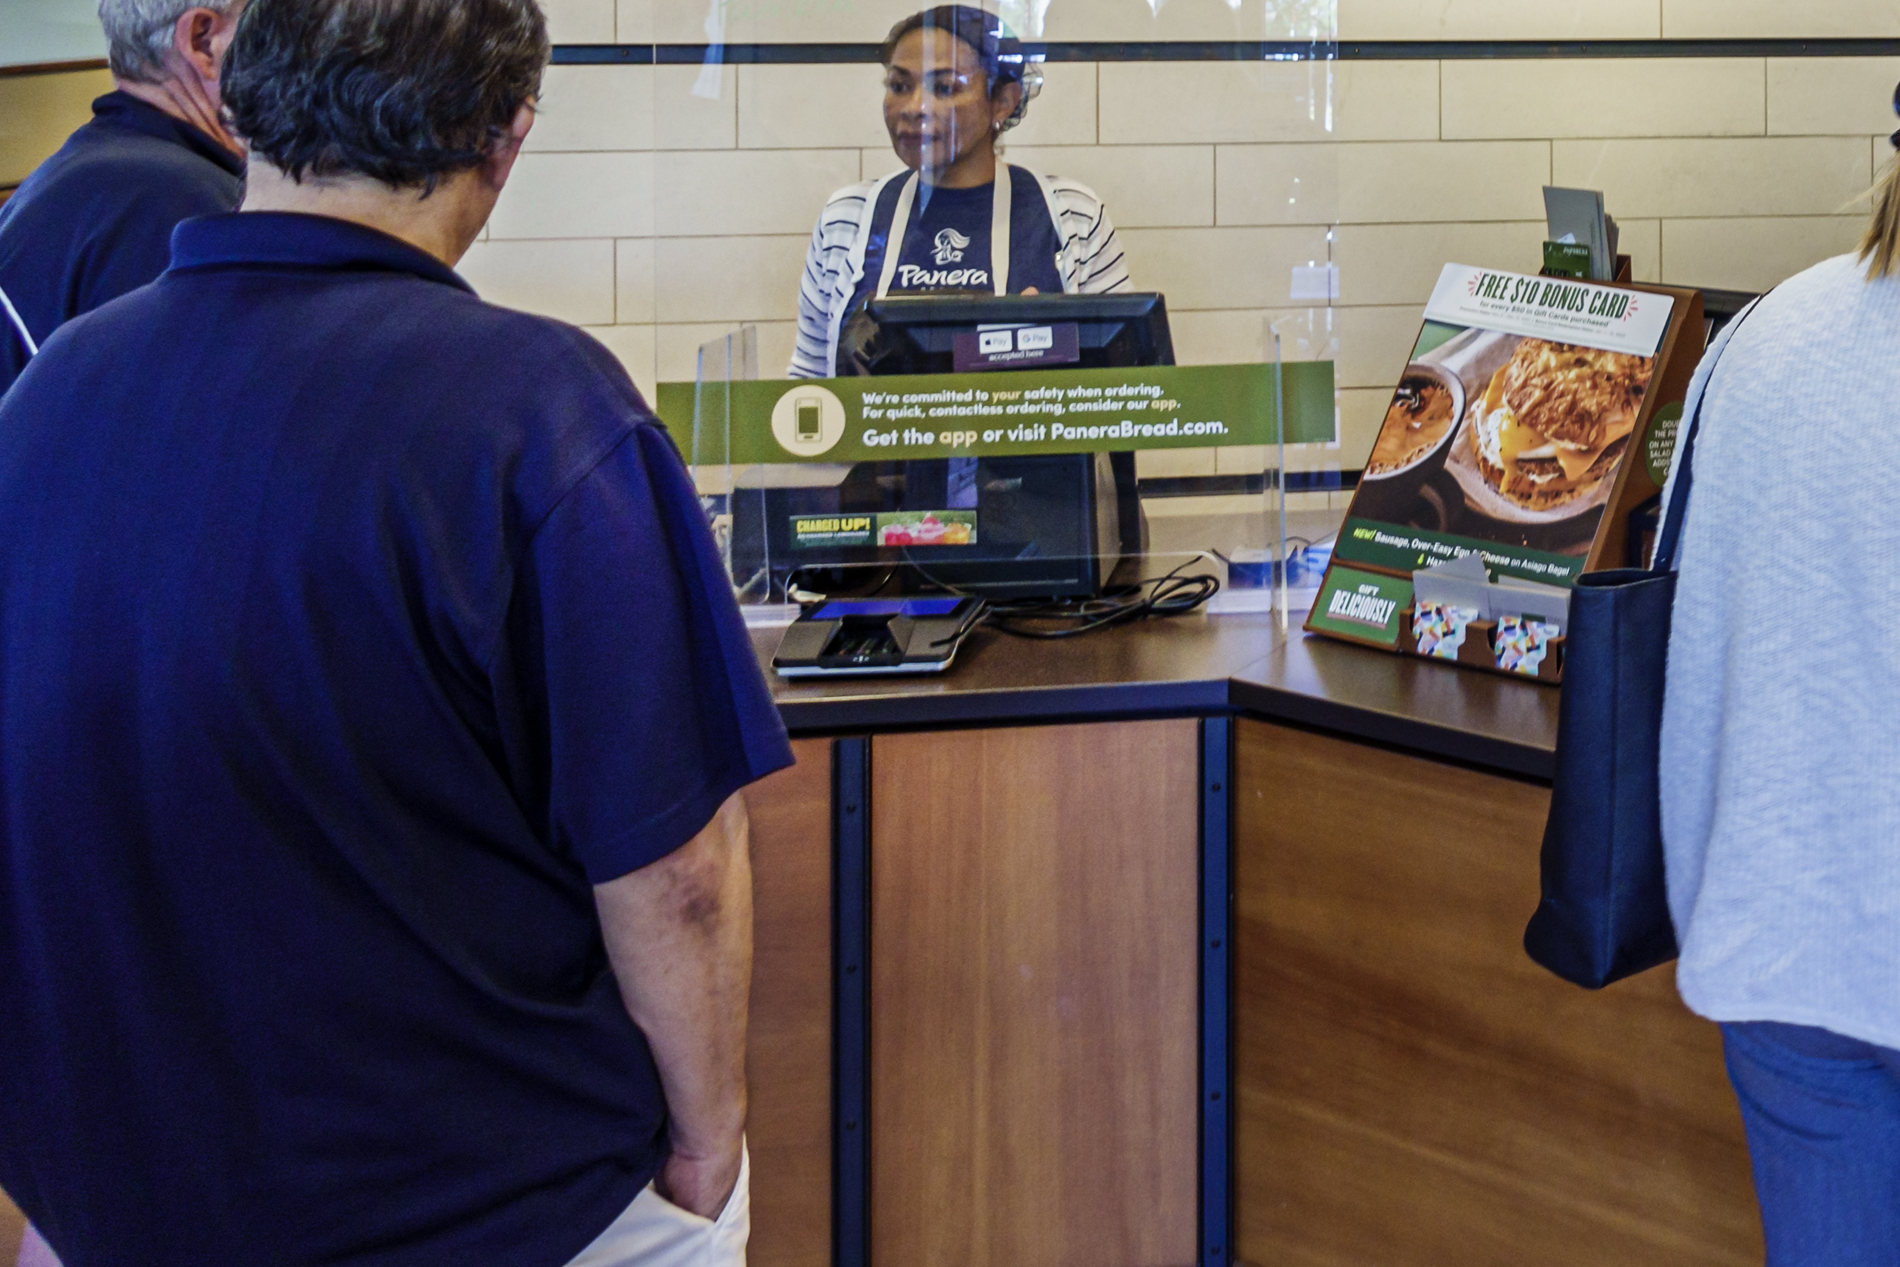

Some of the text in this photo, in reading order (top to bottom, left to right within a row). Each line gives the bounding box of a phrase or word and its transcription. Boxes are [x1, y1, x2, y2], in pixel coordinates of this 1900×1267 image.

[898, 263, 988, 288] Panera
[1475, 273, 1630, 319] FREE $10 BONUS CARD
[862, 418, 1229, 448] Get the app or visit PaneraBread.com.
[1358, 583, 1380, 596] GIFT
[1328, 589, 1397, 625] DELICIOUSLY
